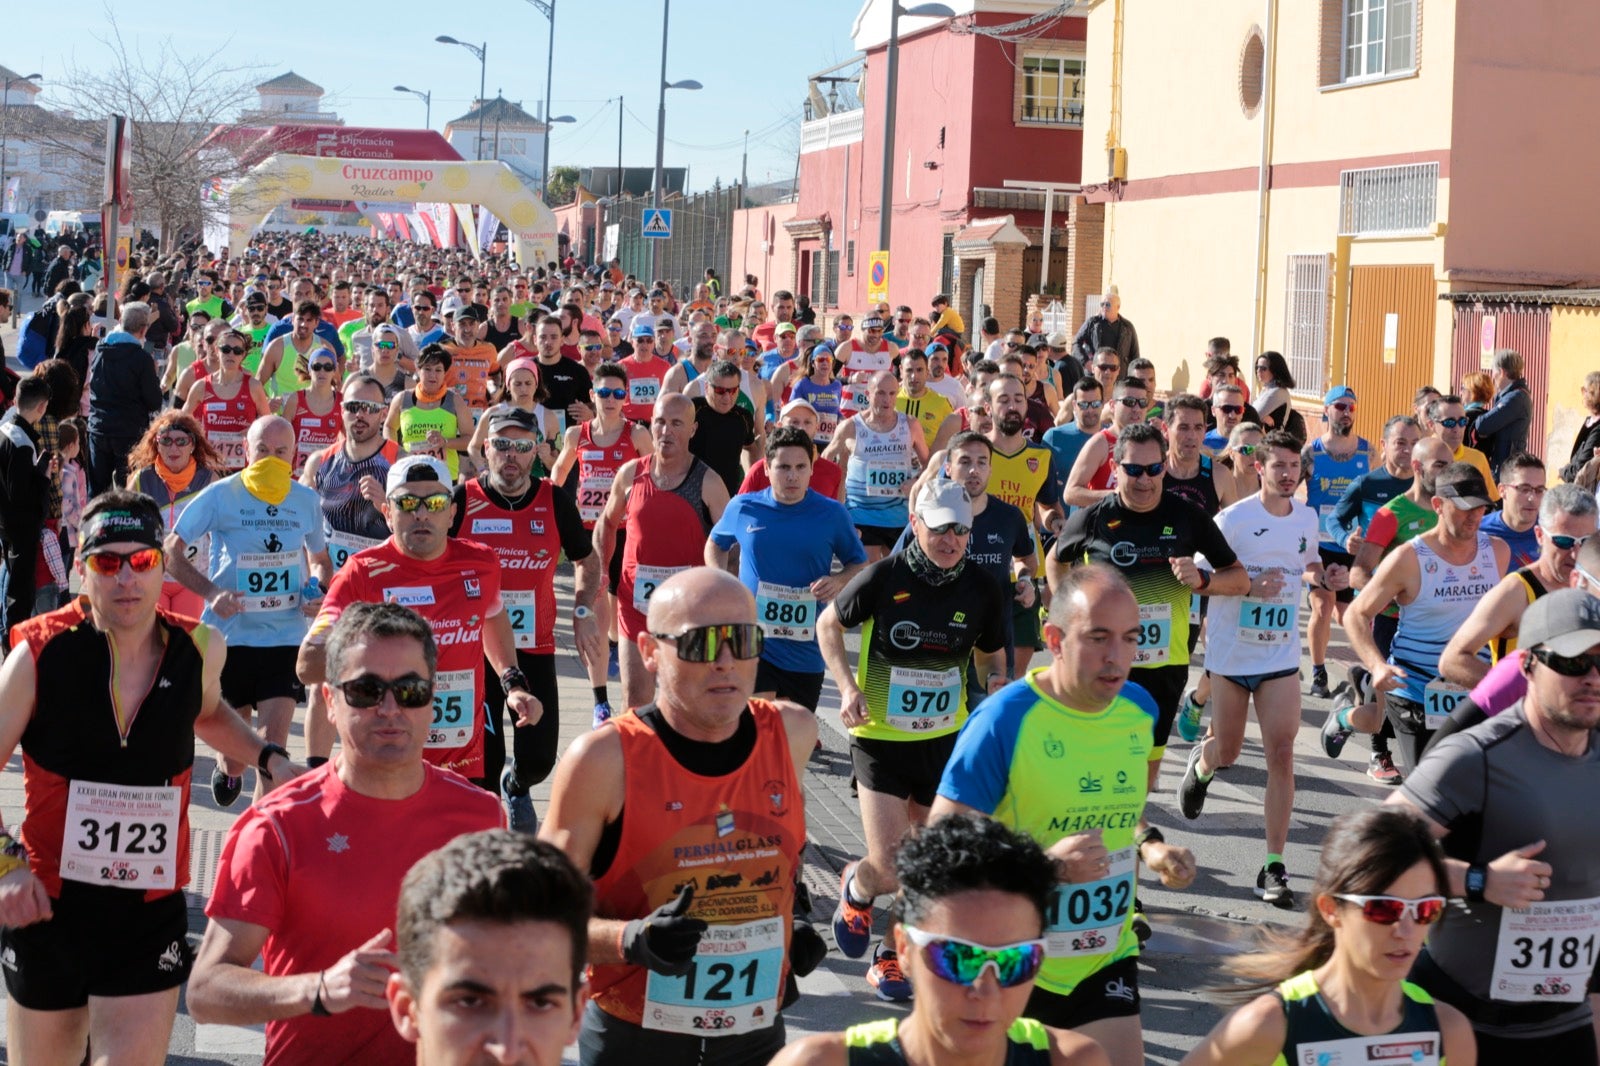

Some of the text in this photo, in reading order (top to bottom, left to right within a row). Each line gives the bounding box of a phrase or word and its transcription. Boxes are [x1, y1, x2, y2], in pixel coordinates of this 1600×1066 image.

[341, 134, 394, 147] Diputación
[340, 148, 394, 159] de Granada
[342, 165, 434, 183] Cruzcampo
[351, 184, 395, 197] Radler
[635, 385, 655, 396] 293
[864, 444, 907, 454] MARACENA
[870, 472, 905, 486] 1083
[1001, 480, 1021, 493] Fly
[248, 570, 290, 593] 921
[765, 601, 808, 624] 880
[1251, 606, 1288, 627] 110
[902, 689, 950, 713] 970
[98, 788, 117, 799] GRAN
[119, 791, 144, 800] PREMIO
[145, 792, 153, 800] DE
[154, 792, 175, 800] FONDO
[78, 819, 168, 854] 3123
[1050, 879, 1131, 926] 1032
[713, 928, 743, 940] PREMIO
[744, 926, 753, 938] DE
[1510, 933, 1595, 969] 3181
[676, 958, 759, 1001] 121
